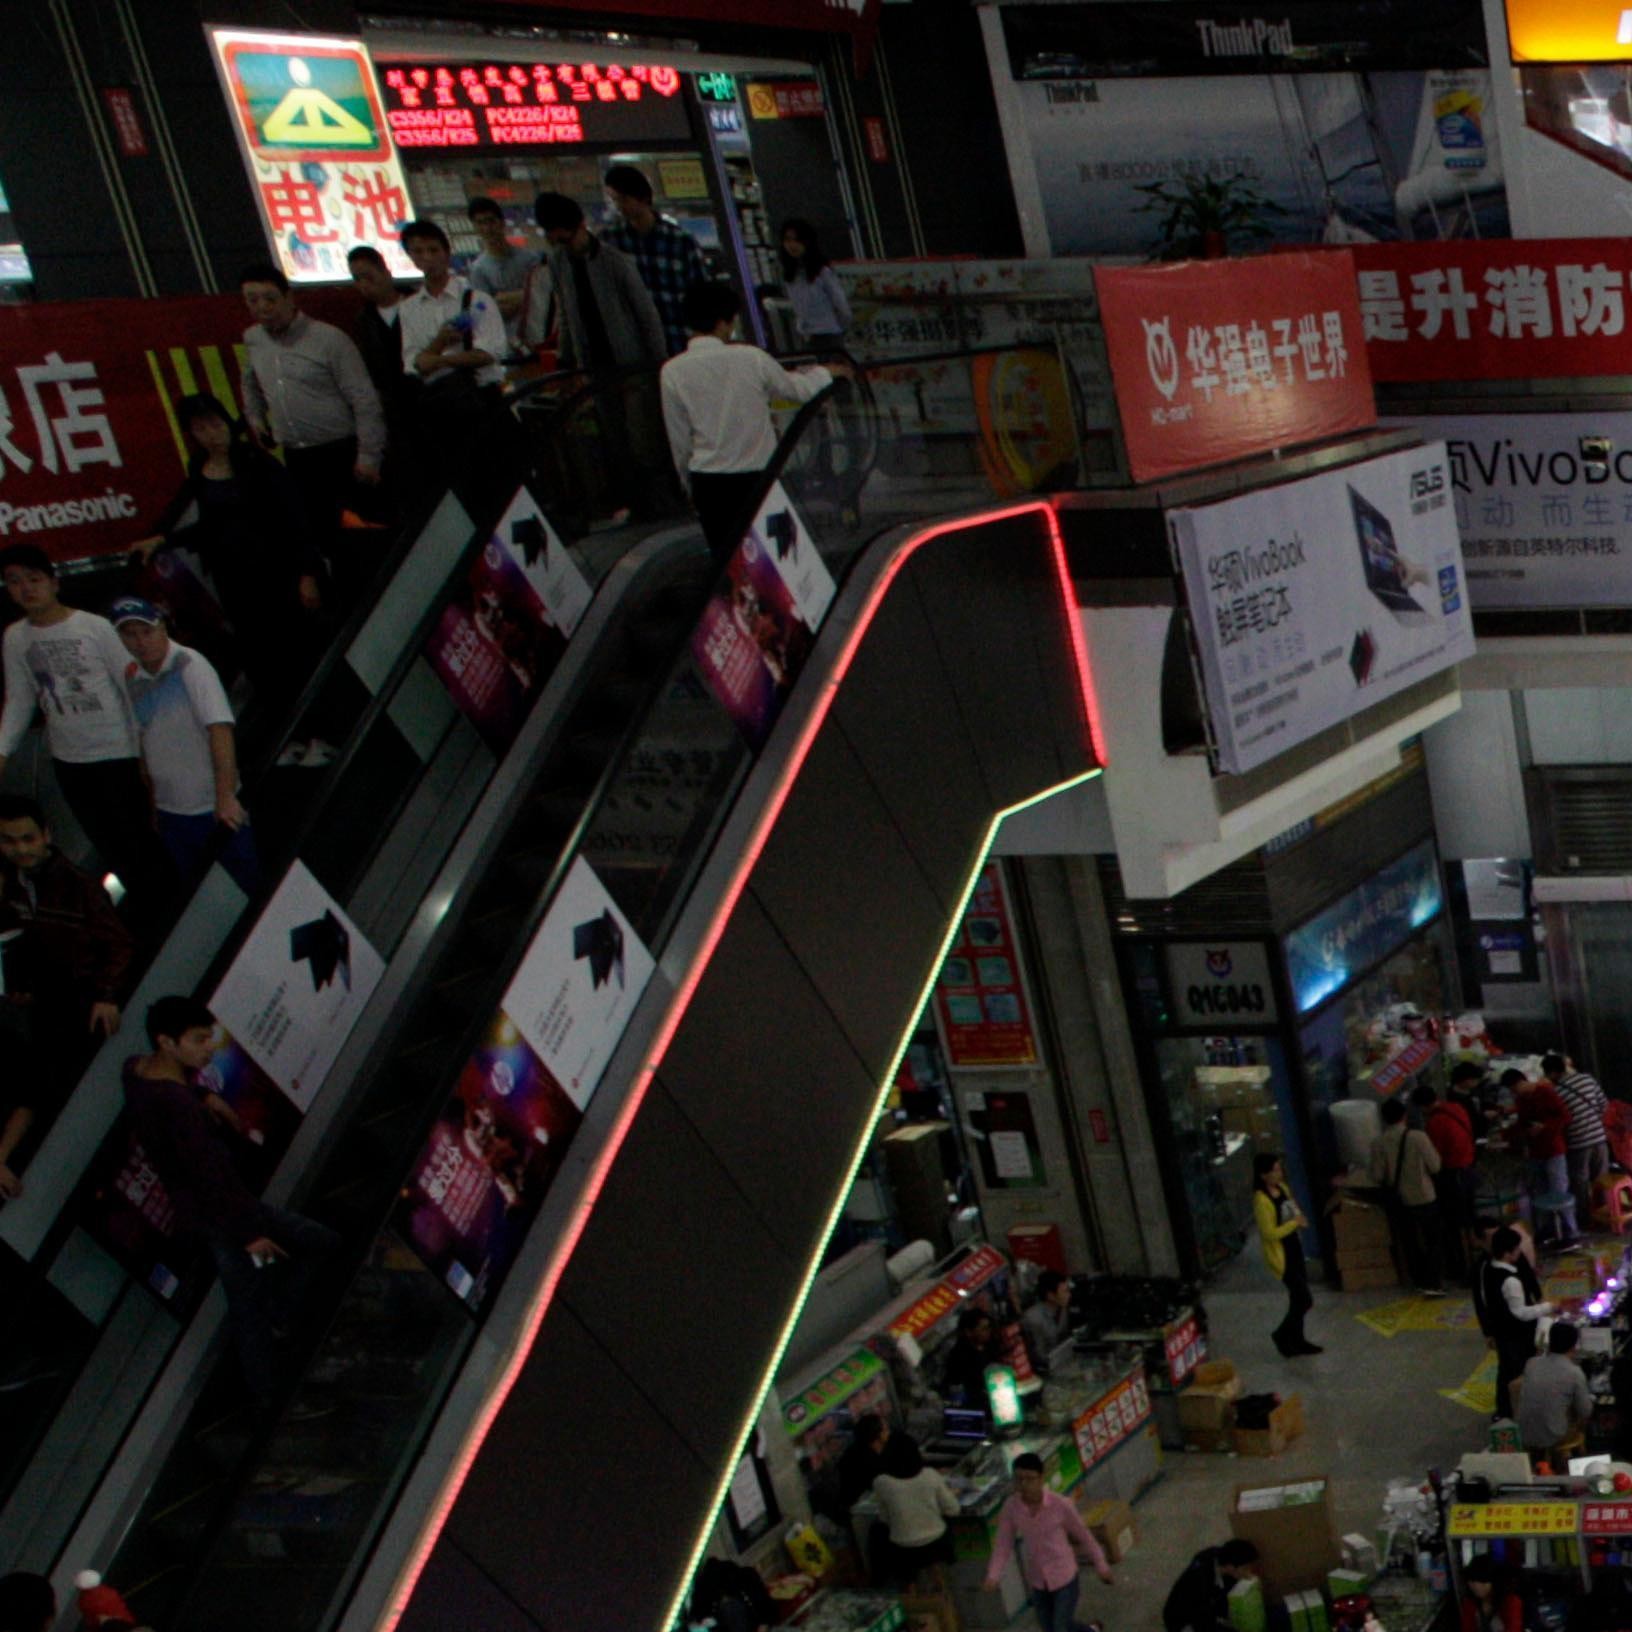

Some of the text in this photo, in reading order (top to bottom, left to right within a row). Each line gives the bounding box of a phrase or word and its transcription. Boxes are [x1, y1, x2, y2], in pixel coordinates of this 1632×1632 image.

[1195, 18, 1294, 57] ThinkPad
[261, 170, 415, 245] 电池
[1184, 310, 1349, 402] 华强电子世界
[0, 487, 138, 536] Panasonic
